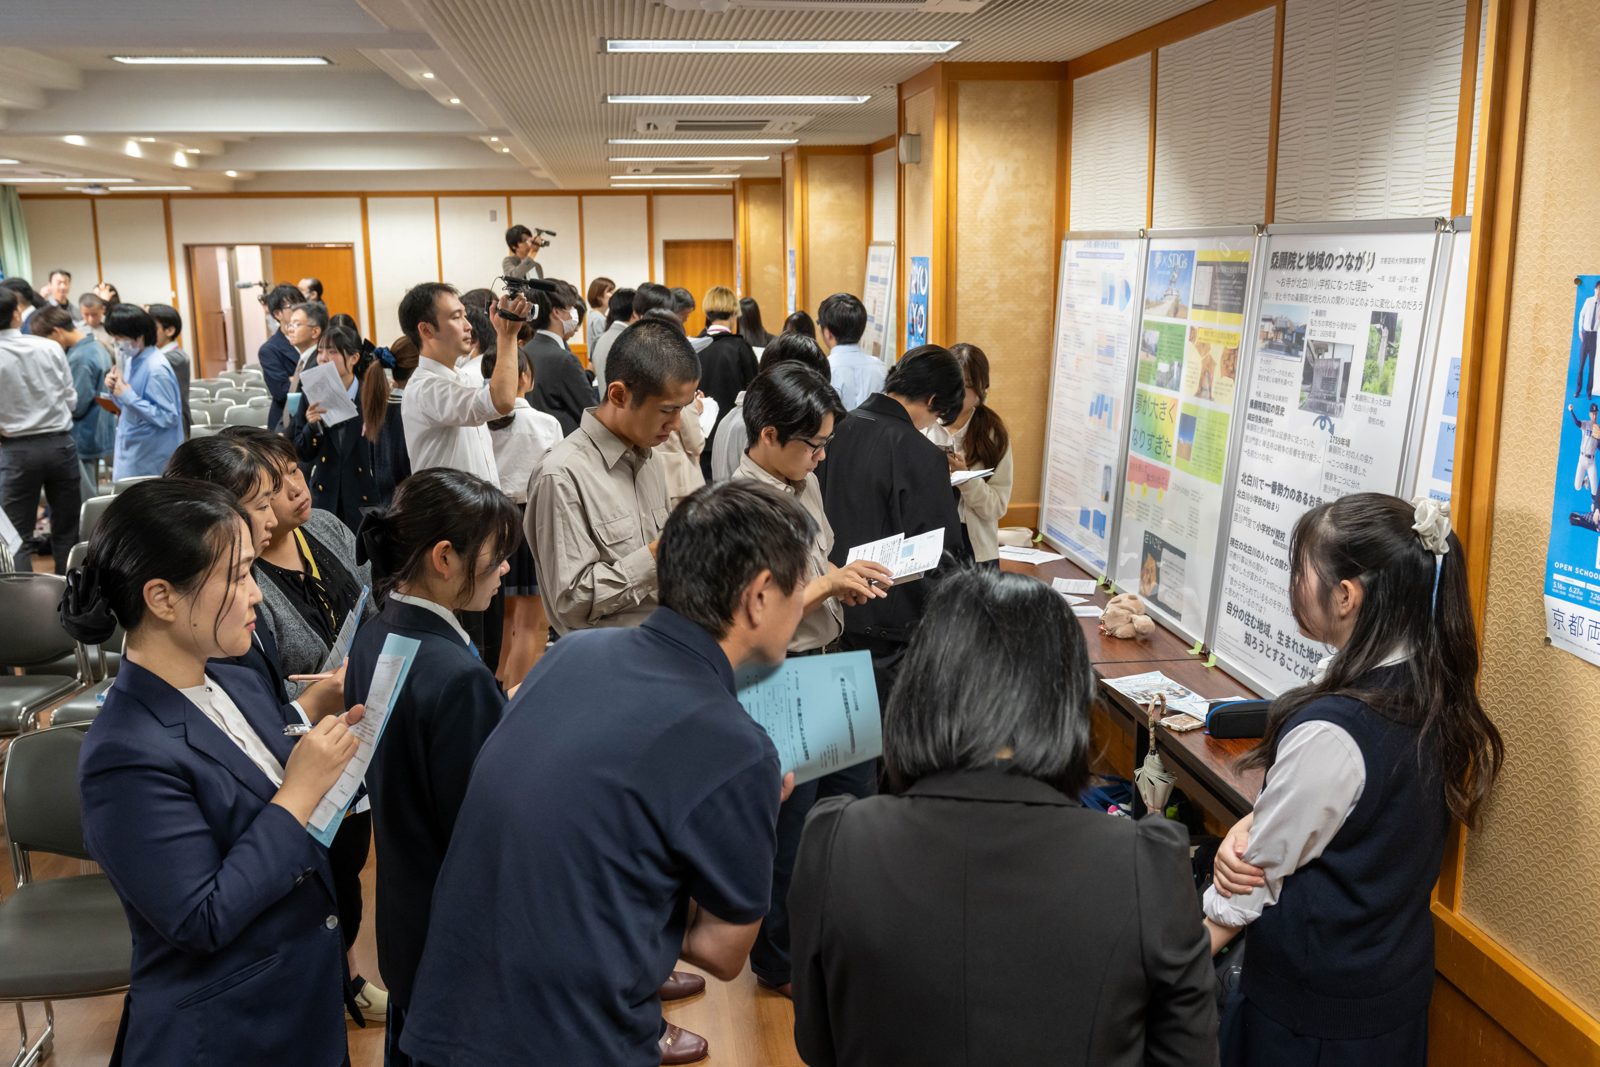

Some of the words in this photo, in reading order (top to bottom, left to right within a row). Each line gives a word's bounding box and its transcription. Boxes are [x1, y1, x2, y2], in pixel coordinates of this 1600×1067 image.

[1132, 427, 1173, 459] なりすぎた
[1554, 561, 1573, 574] OPEN
